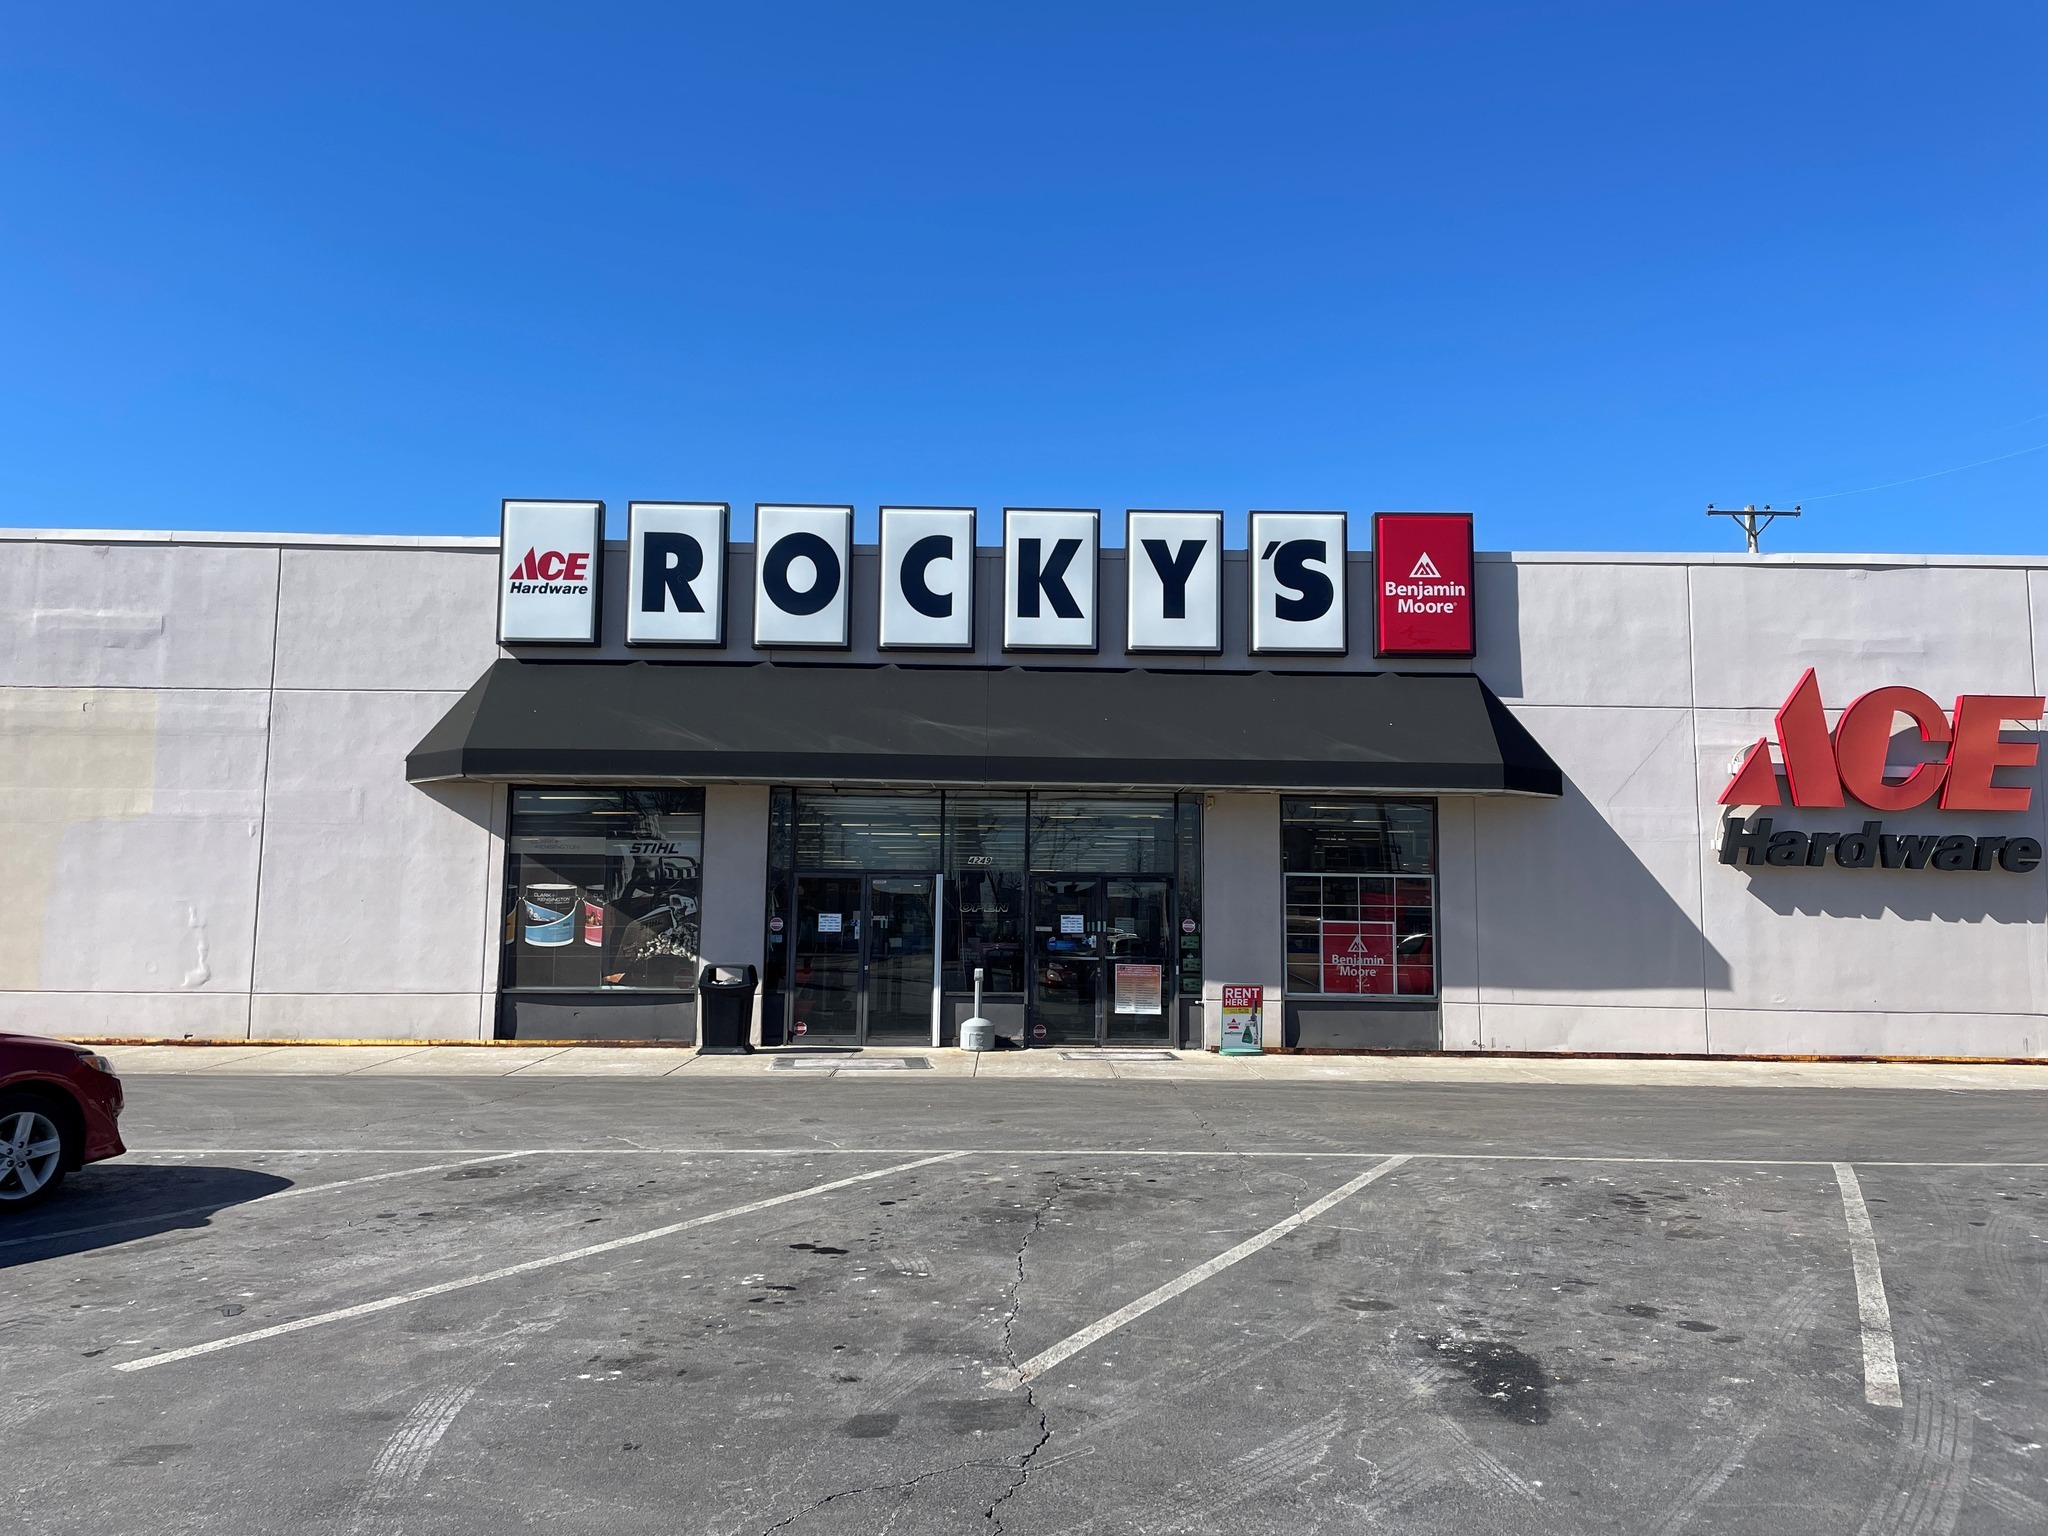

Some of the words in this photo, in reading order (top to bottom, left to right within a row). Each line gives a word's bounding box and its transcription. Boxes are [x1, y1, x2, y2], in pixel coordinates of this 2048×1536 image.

[508, 546, 590, 581] ACE
[641, 531, 1335, 622] ROCKY'S
[510, 581, 588, 596] Hardware
[1385, 580, 1466, 599] Benjamin
[1397, 598, 1454, 614] Moore
[1716, 666, 2047, 811] ACE
[630, 842, 679, 854] STIHL
[1718, 817, 2043, 873] Hardware
[967, 855, 993, 865] 4249
[960, 903, 1010, 913] OPEN
[1331, 954, 1384, 967] Benjamin
[1340, 966, 1377, 977] Moore
[1225, 987, 1260, 999] RENT
[1225, 998, 1249, 1006] HERE
